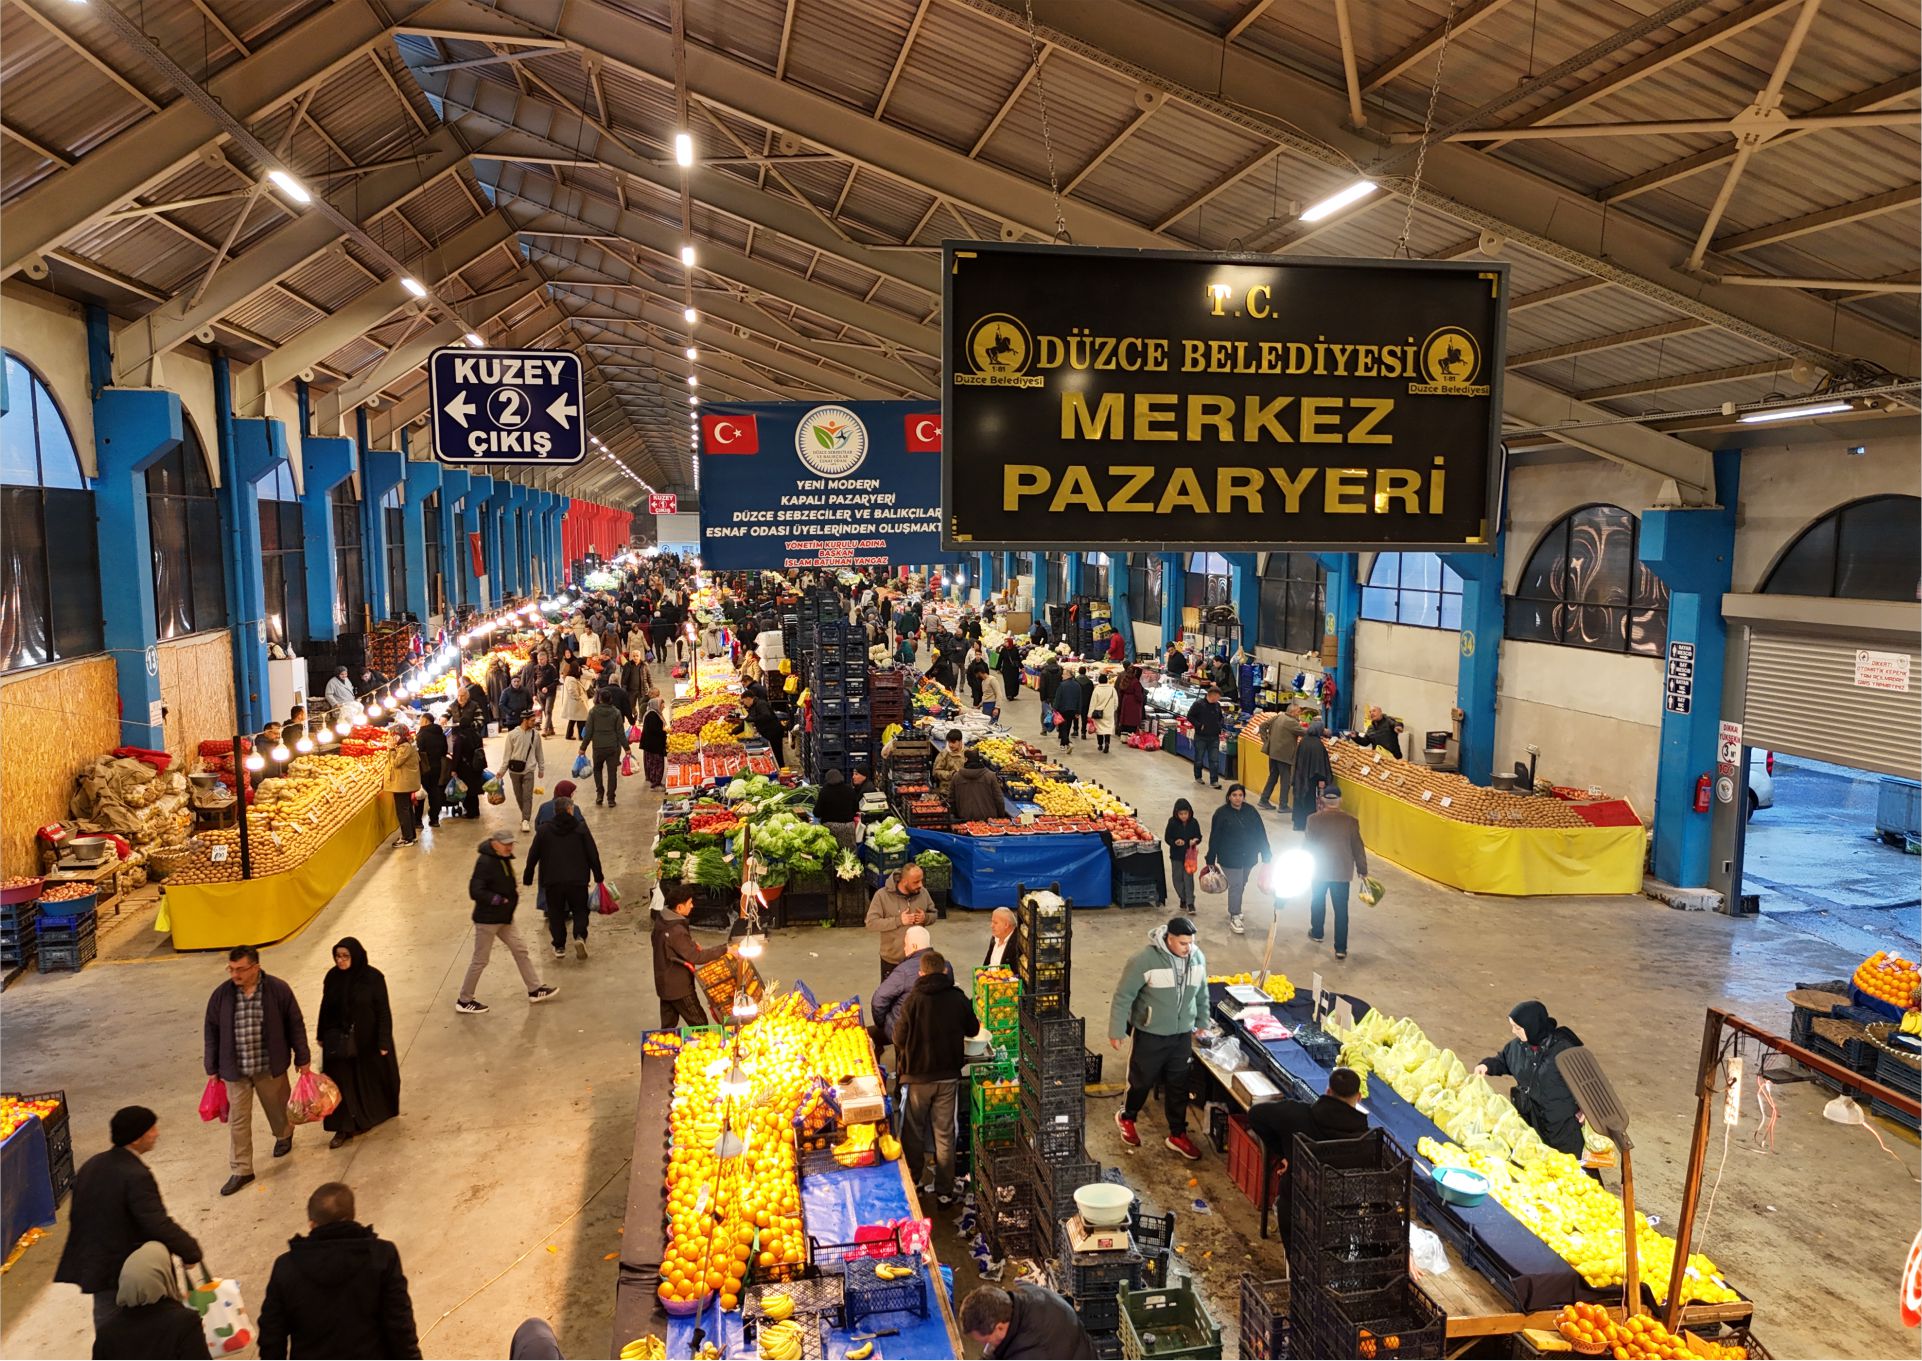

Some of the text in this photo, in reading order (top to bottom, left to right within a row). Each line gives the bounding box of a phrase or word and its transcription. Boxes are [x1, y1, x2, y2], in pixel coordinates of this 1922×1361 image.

[1036, 327, 1418, 377] DÜZCE BELEDİYESİ
[454, 357, 566, 385] KUZEY
[990, 376, 1043, 387] Belediyesi
[1441, 385, 1489, 396] Belediyesi
[498, 390, 521, 424] 2
[1060, 391, 1394, 445] MERKEZ
[467, 430, 552, 457] ÇIKIŞ
[796, 478, 880, 491] YENİ MODERN
[1002, 455, 1446, 515] PAZARYERİ
[780, 492, 896, 507] KAPALI PAZARYERİ
[733, 509, 774, 522] DÜZCE
[777, 508, 853, 522] SEBZECİLER
[855, 509, 871, 519] VE
[706, 526, 747, 537] ESNAF
[750, 525, 790, 536] ODASI
[793, 523, 876, 538] ÜYELERİNDEN
[785, 539, 886, 550] YÖNETİM KURULU ADINA
[784, 557, 812, 568] İSLAM
[813, 557, 852, 567] BATUHAN
